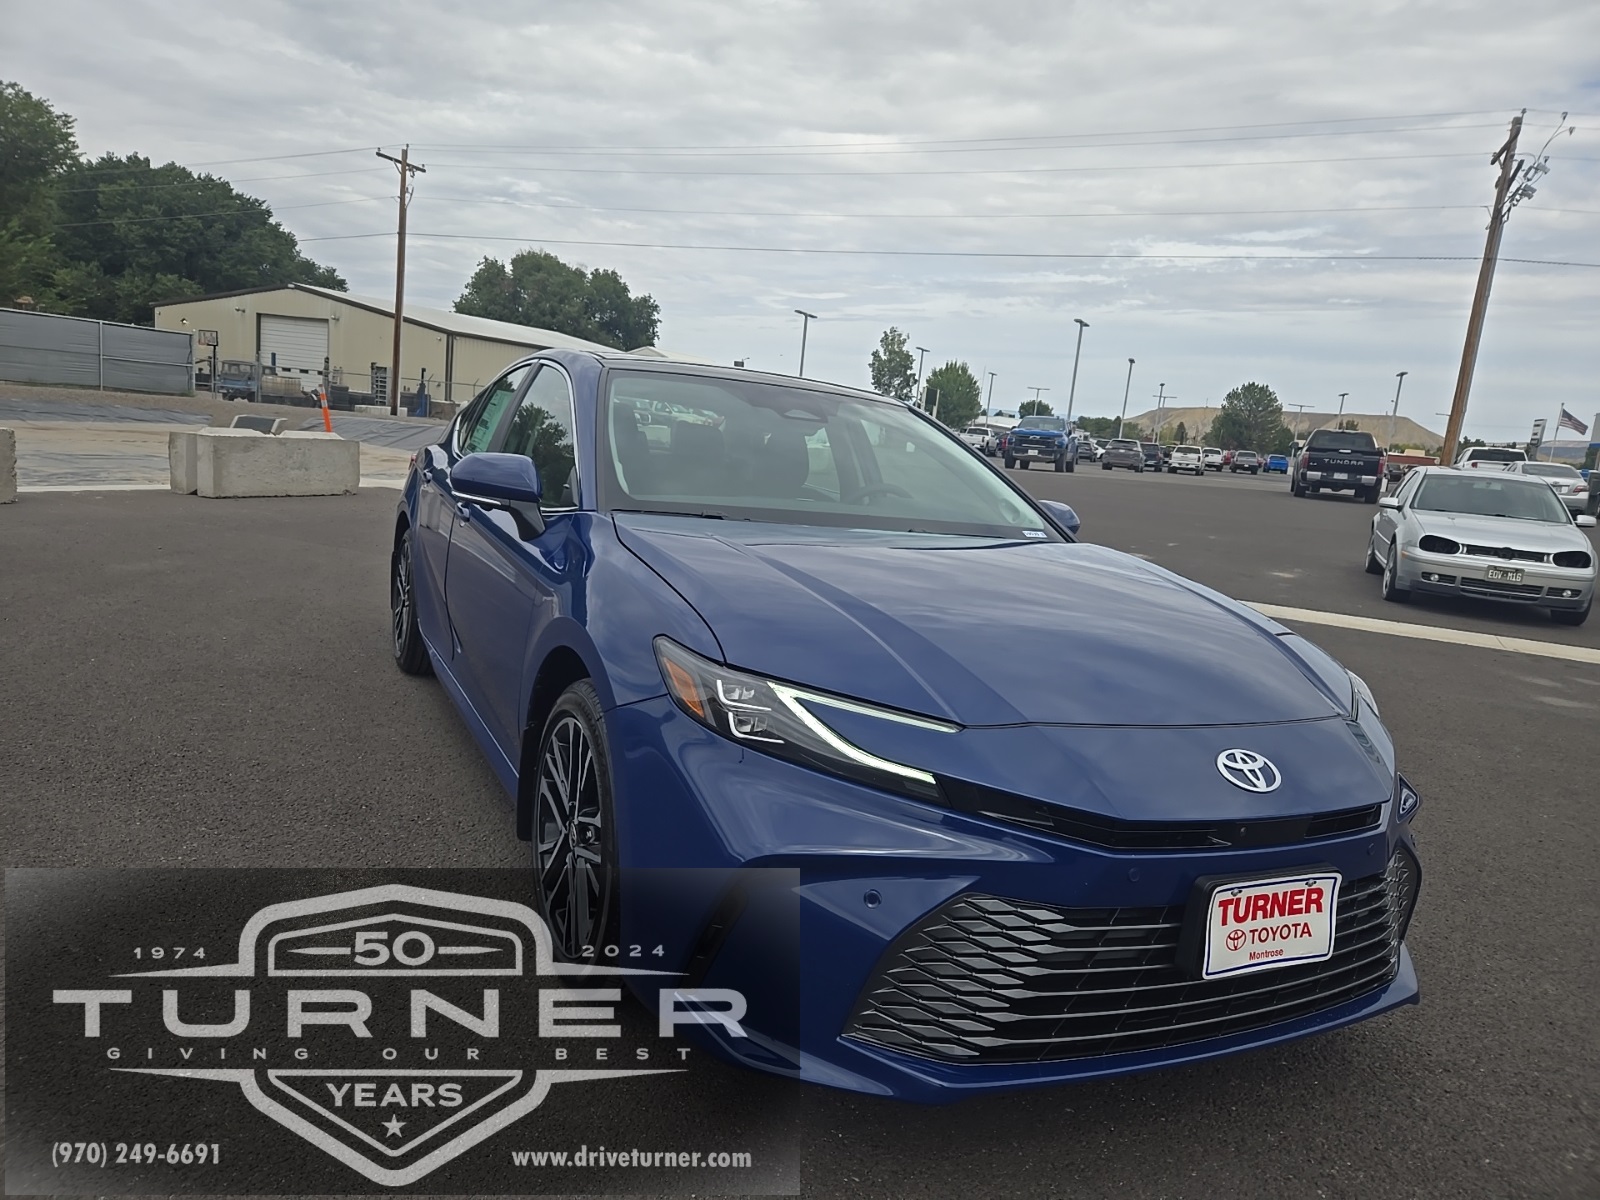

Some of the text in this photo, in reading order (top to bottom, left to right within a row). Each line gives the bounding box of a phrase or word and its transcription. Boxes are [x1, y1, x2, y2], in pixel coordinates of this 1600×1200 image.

[1323, 458, 1364, 466] TUNDRA
[1218, 887, 1324, 927] TURNER
[1249, 922, 1312, 945] TOYOTA
[1249, 948, 1284, 961] Montrose
